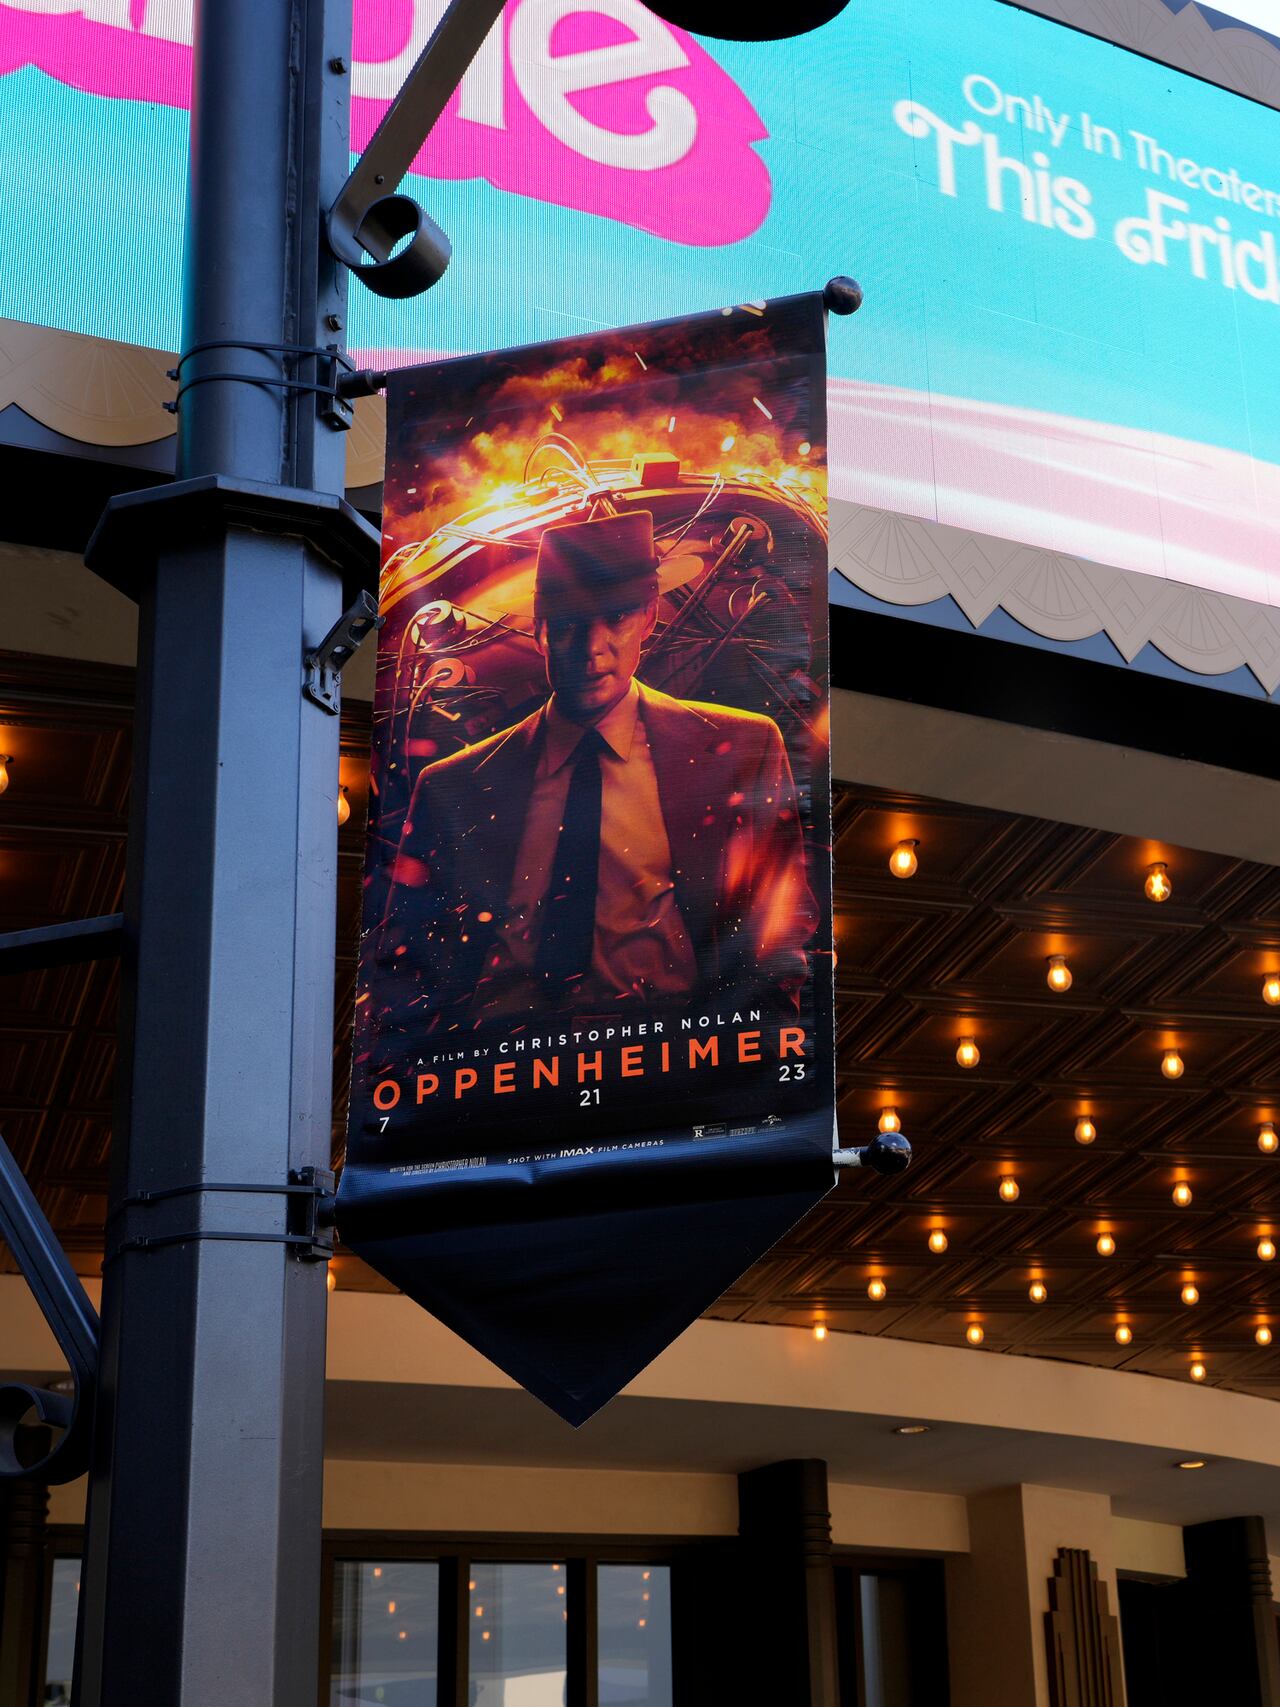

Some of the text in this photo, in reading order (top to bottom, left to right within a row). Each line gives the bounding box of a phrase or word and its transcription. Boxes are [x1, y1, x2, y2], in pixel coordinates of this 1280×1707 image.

[962, 74, 1071, 148] Only
[1081, 111, 1122, 160] In
[893, 98, 1096, 240] This
[417, 1009, 761, 1066] A FILM BY CHRISTOPHER NOLAN
[373, 1027, 806, 1111] OPPENHEIMER
[778, 1063, 806, 1082] 23
[579, 1088, 601, 1107] 21
[379, 1116, 390, 1134] 7
[694, 1129, 703, 1138] R
[507, 1139, 664, 1165] SHOT WITH IMAX FILM CAMERAS
